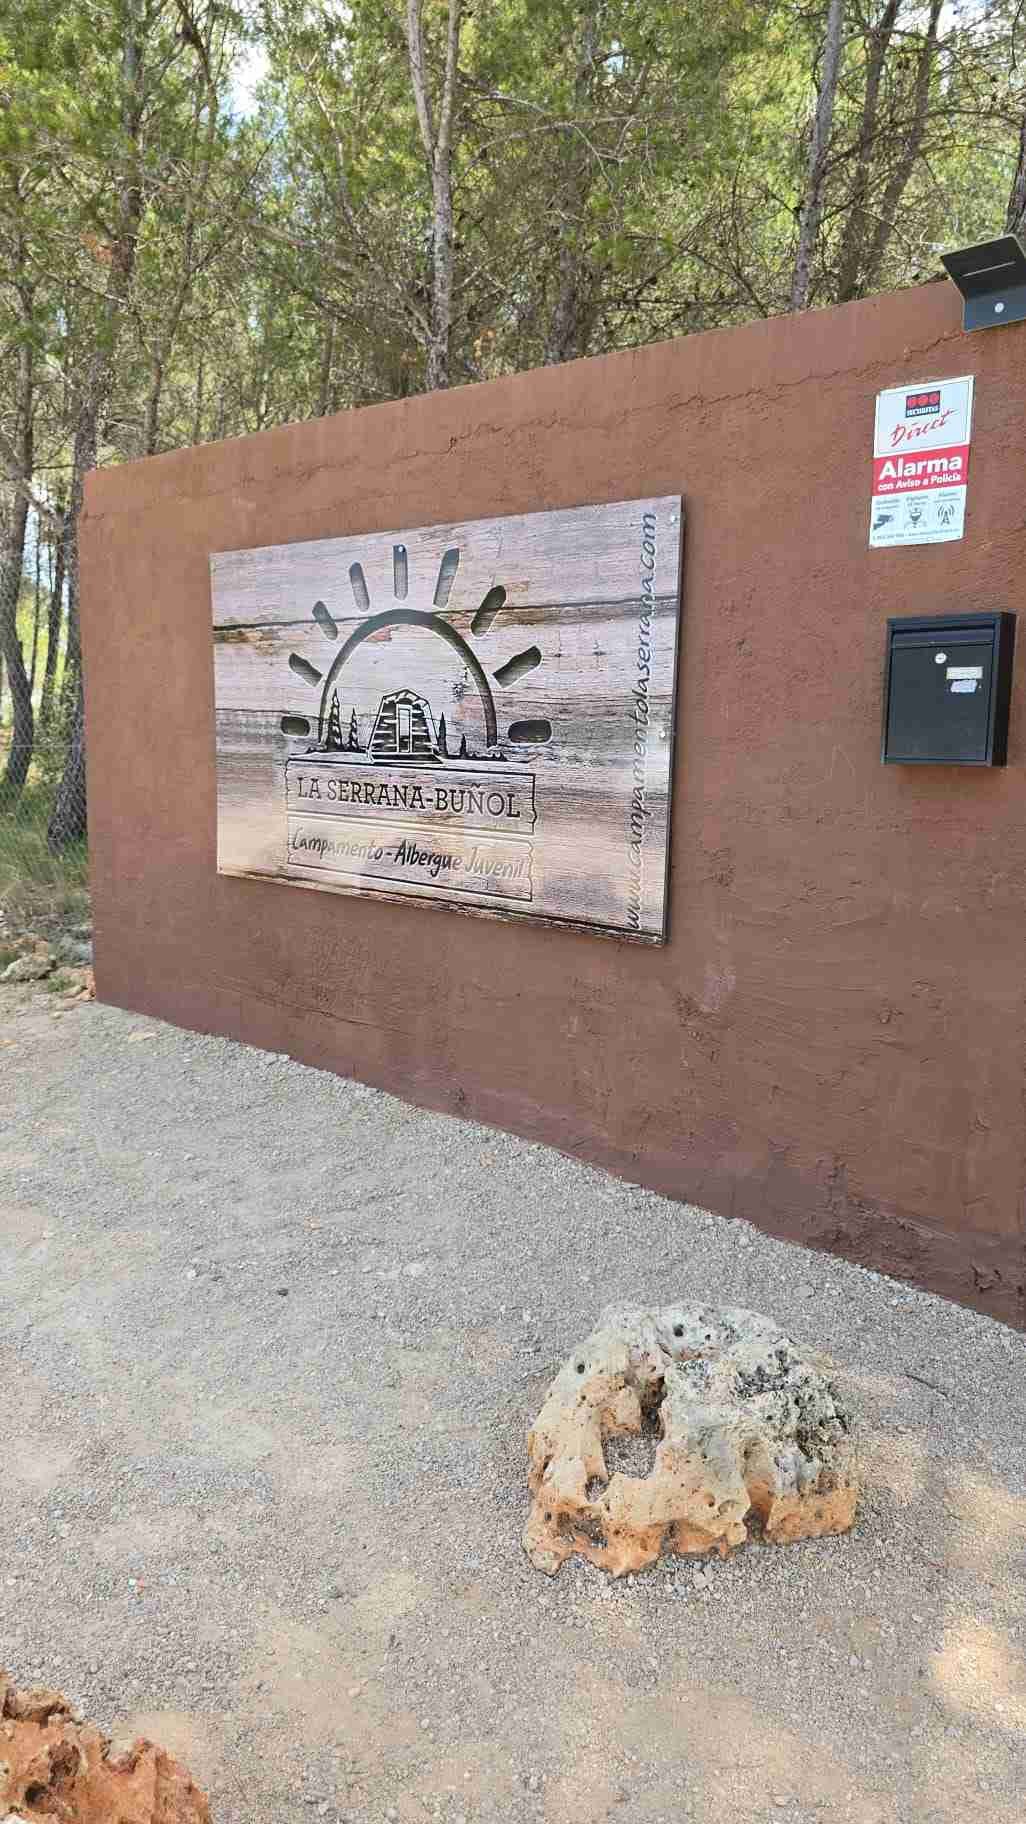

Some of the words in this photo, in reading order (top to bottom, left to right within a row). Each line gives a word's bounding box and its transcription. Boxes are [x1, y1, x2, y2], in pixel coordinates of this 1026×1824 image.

[879, 456, 962, 480] Alarma
[877, 482, 894, 491] con
[896, 478, 920, 488] Aviso
[297, 777, 322, 799] LA
[327, 779, 521, 818] SERRANA-BUÑOL
[464, 847, 524, 879] Juvenil
